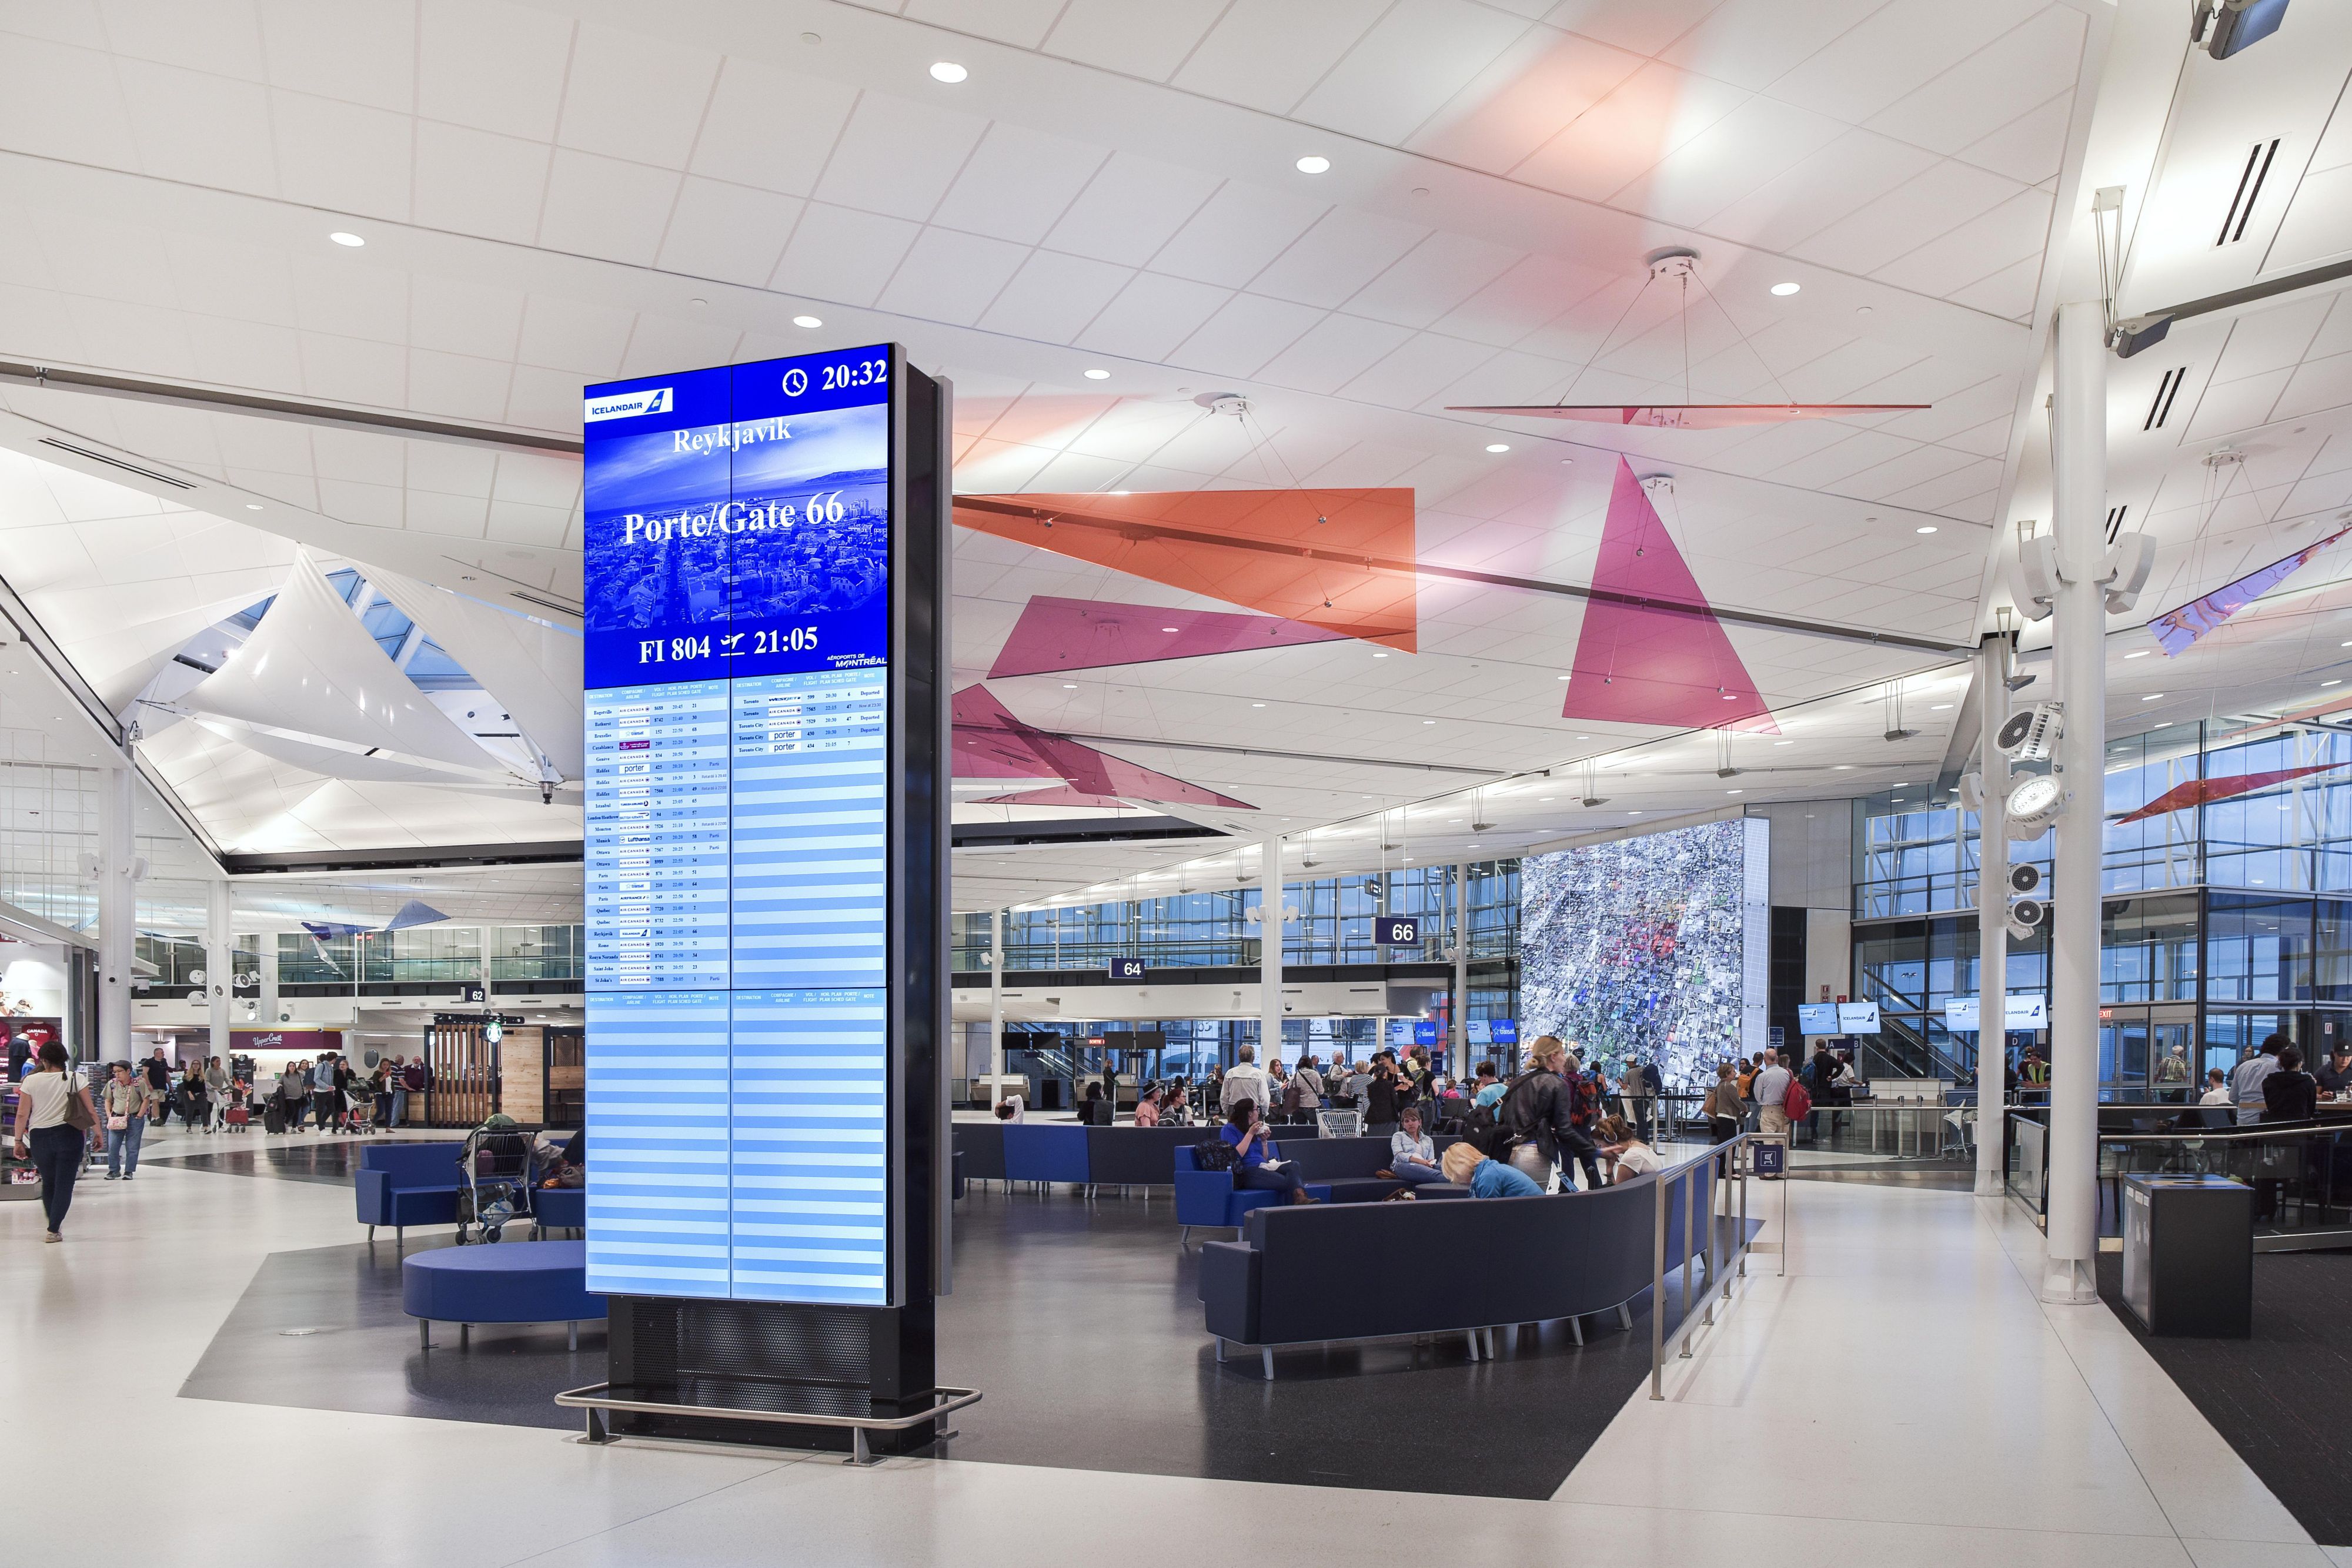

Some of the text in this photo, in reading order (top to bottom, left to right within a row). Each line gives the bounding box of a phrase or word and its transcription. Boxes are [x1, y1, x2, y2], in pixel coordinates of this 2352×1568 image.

[821, 359, 887, 390] 20:32
[592, 402, 643, 415] ICELANDAIR
[673, 418, 792, 455] Reykjavik
[623, 490, 844, 544] Porte/Gate 66
[639, 626, 818, 664] FI 804 21:05
[836, 656, 887, 668] MONTRÉAL
[774, 730, 795, 740] porter
[774, 743, 795, 752] porter
[624, 765, 645, 774] porter
[1392, 924, 1414, 941] 66
[1124, 962, 1141, 975] 64
[472, 991, 483, 1001] 62
[253, 1033, 282, 1048] Upper Crust
